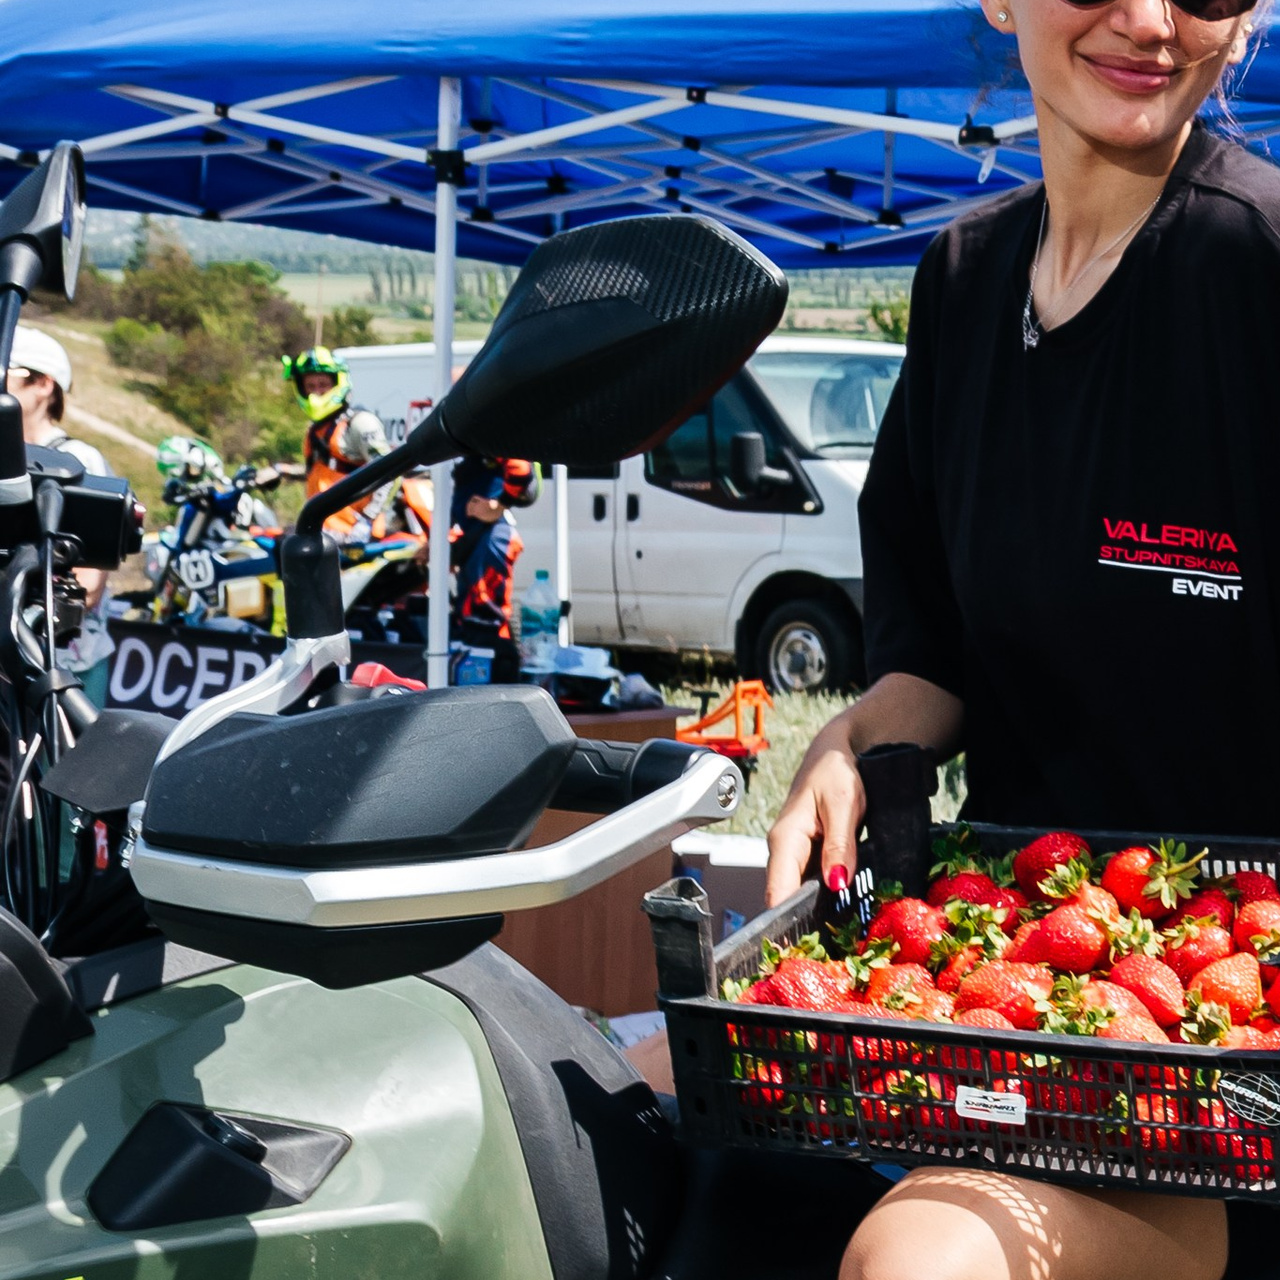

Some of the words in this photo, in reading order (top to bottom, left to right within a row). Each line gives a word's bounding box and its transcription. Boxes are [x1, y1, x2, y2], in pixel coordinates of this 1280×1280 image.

[1103, 518, 1238, 552] VALERIYA
[1100, 545, 1240, 573] STUPNITSKAYA
[1172, 578, 1243, 600] EVENT
